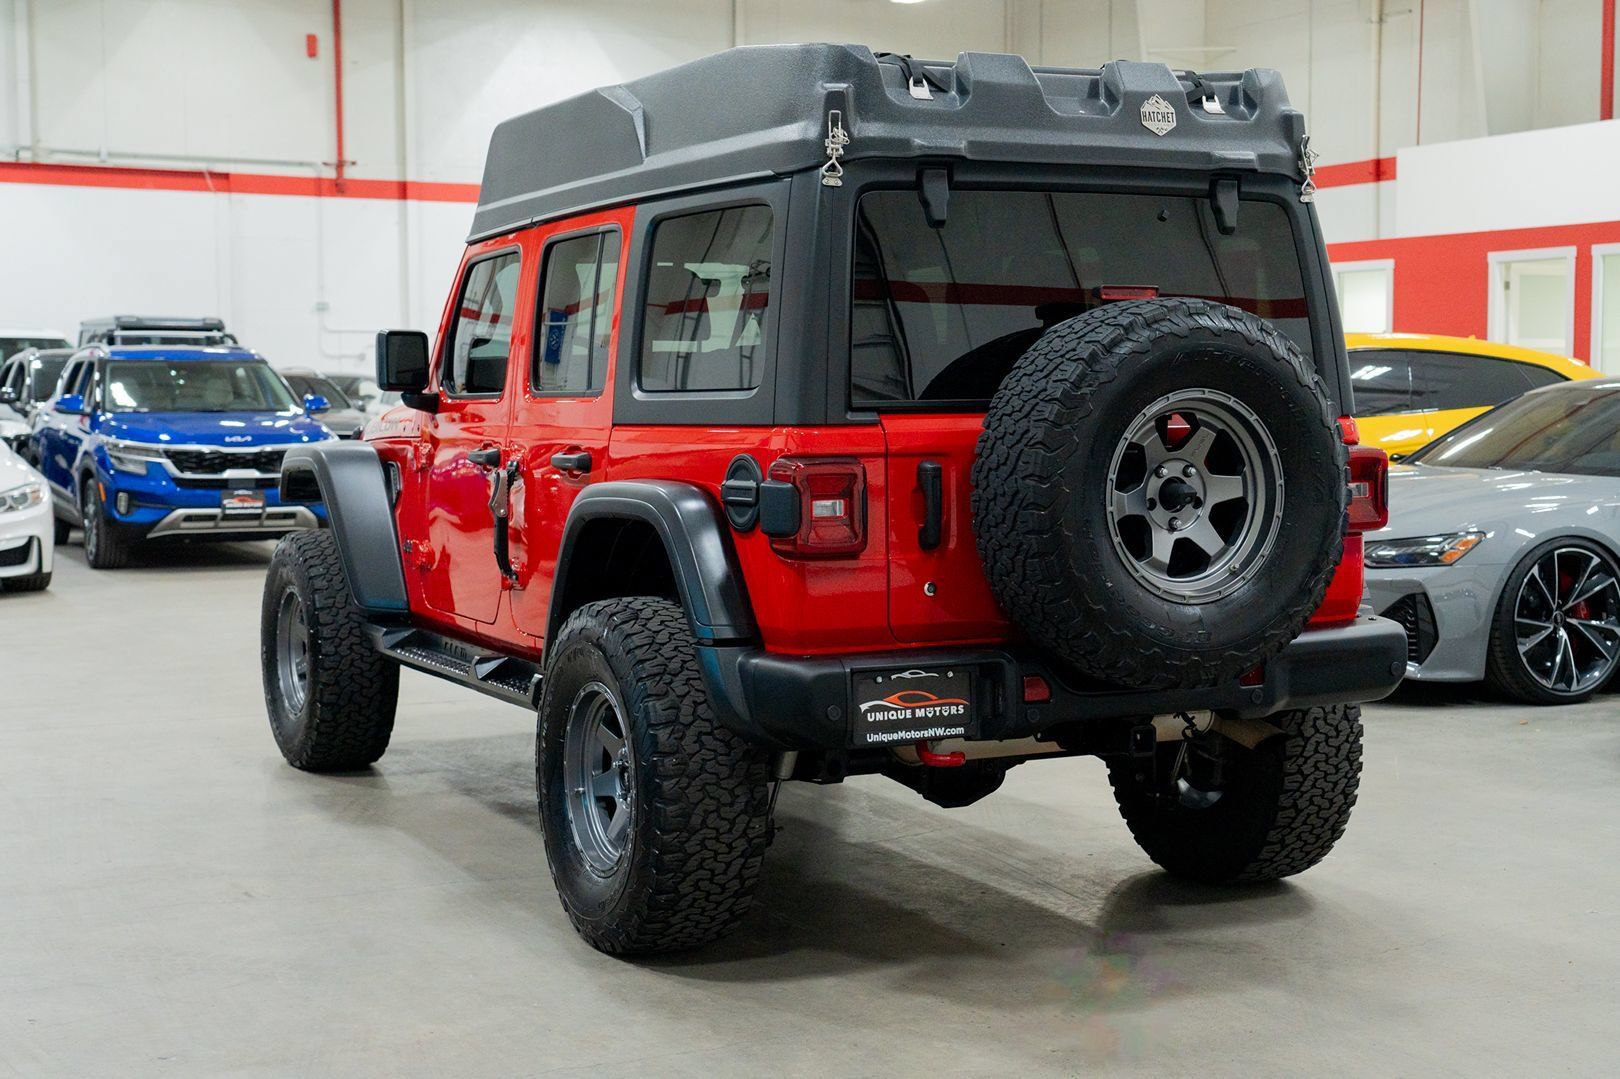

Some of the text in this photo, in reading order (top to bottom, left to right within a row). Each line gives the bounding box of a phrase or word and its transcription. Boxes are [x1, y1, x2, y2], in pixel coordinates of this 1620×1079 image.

[1142, 111, 1174, 123] HATCHET
[867, 705, 964, 722] UNIQUE MOTORS
[866, 727, 965, 742] UniqueMotorsNW.com
